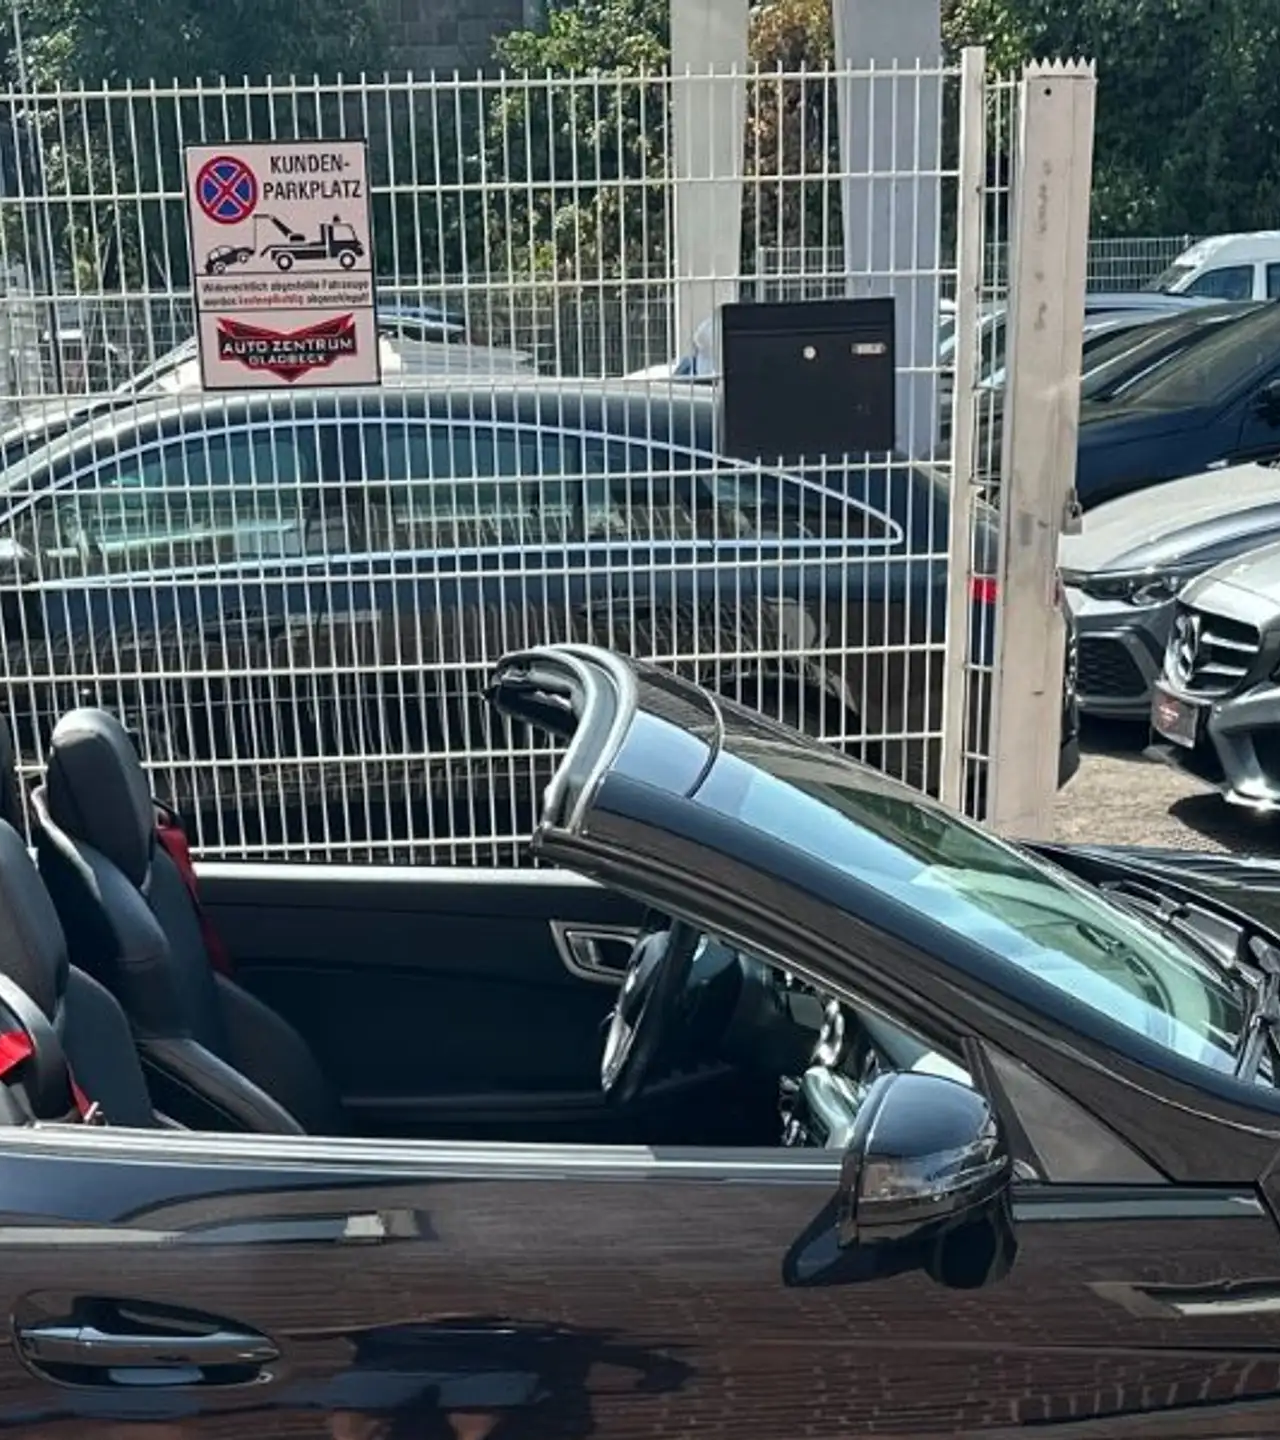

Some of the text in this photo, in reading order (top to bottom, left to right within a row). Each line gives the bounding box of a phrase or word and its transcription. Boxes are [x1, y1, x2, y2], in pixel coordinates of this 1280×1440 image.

[270, 154, 350, 174] KUNDEN-
[263, 180, 362, 200] PARKPLATZ
[223, 337, 353, 354] AUTO ZENTRUM
[248, 353, 327, 366] GLADBECK
